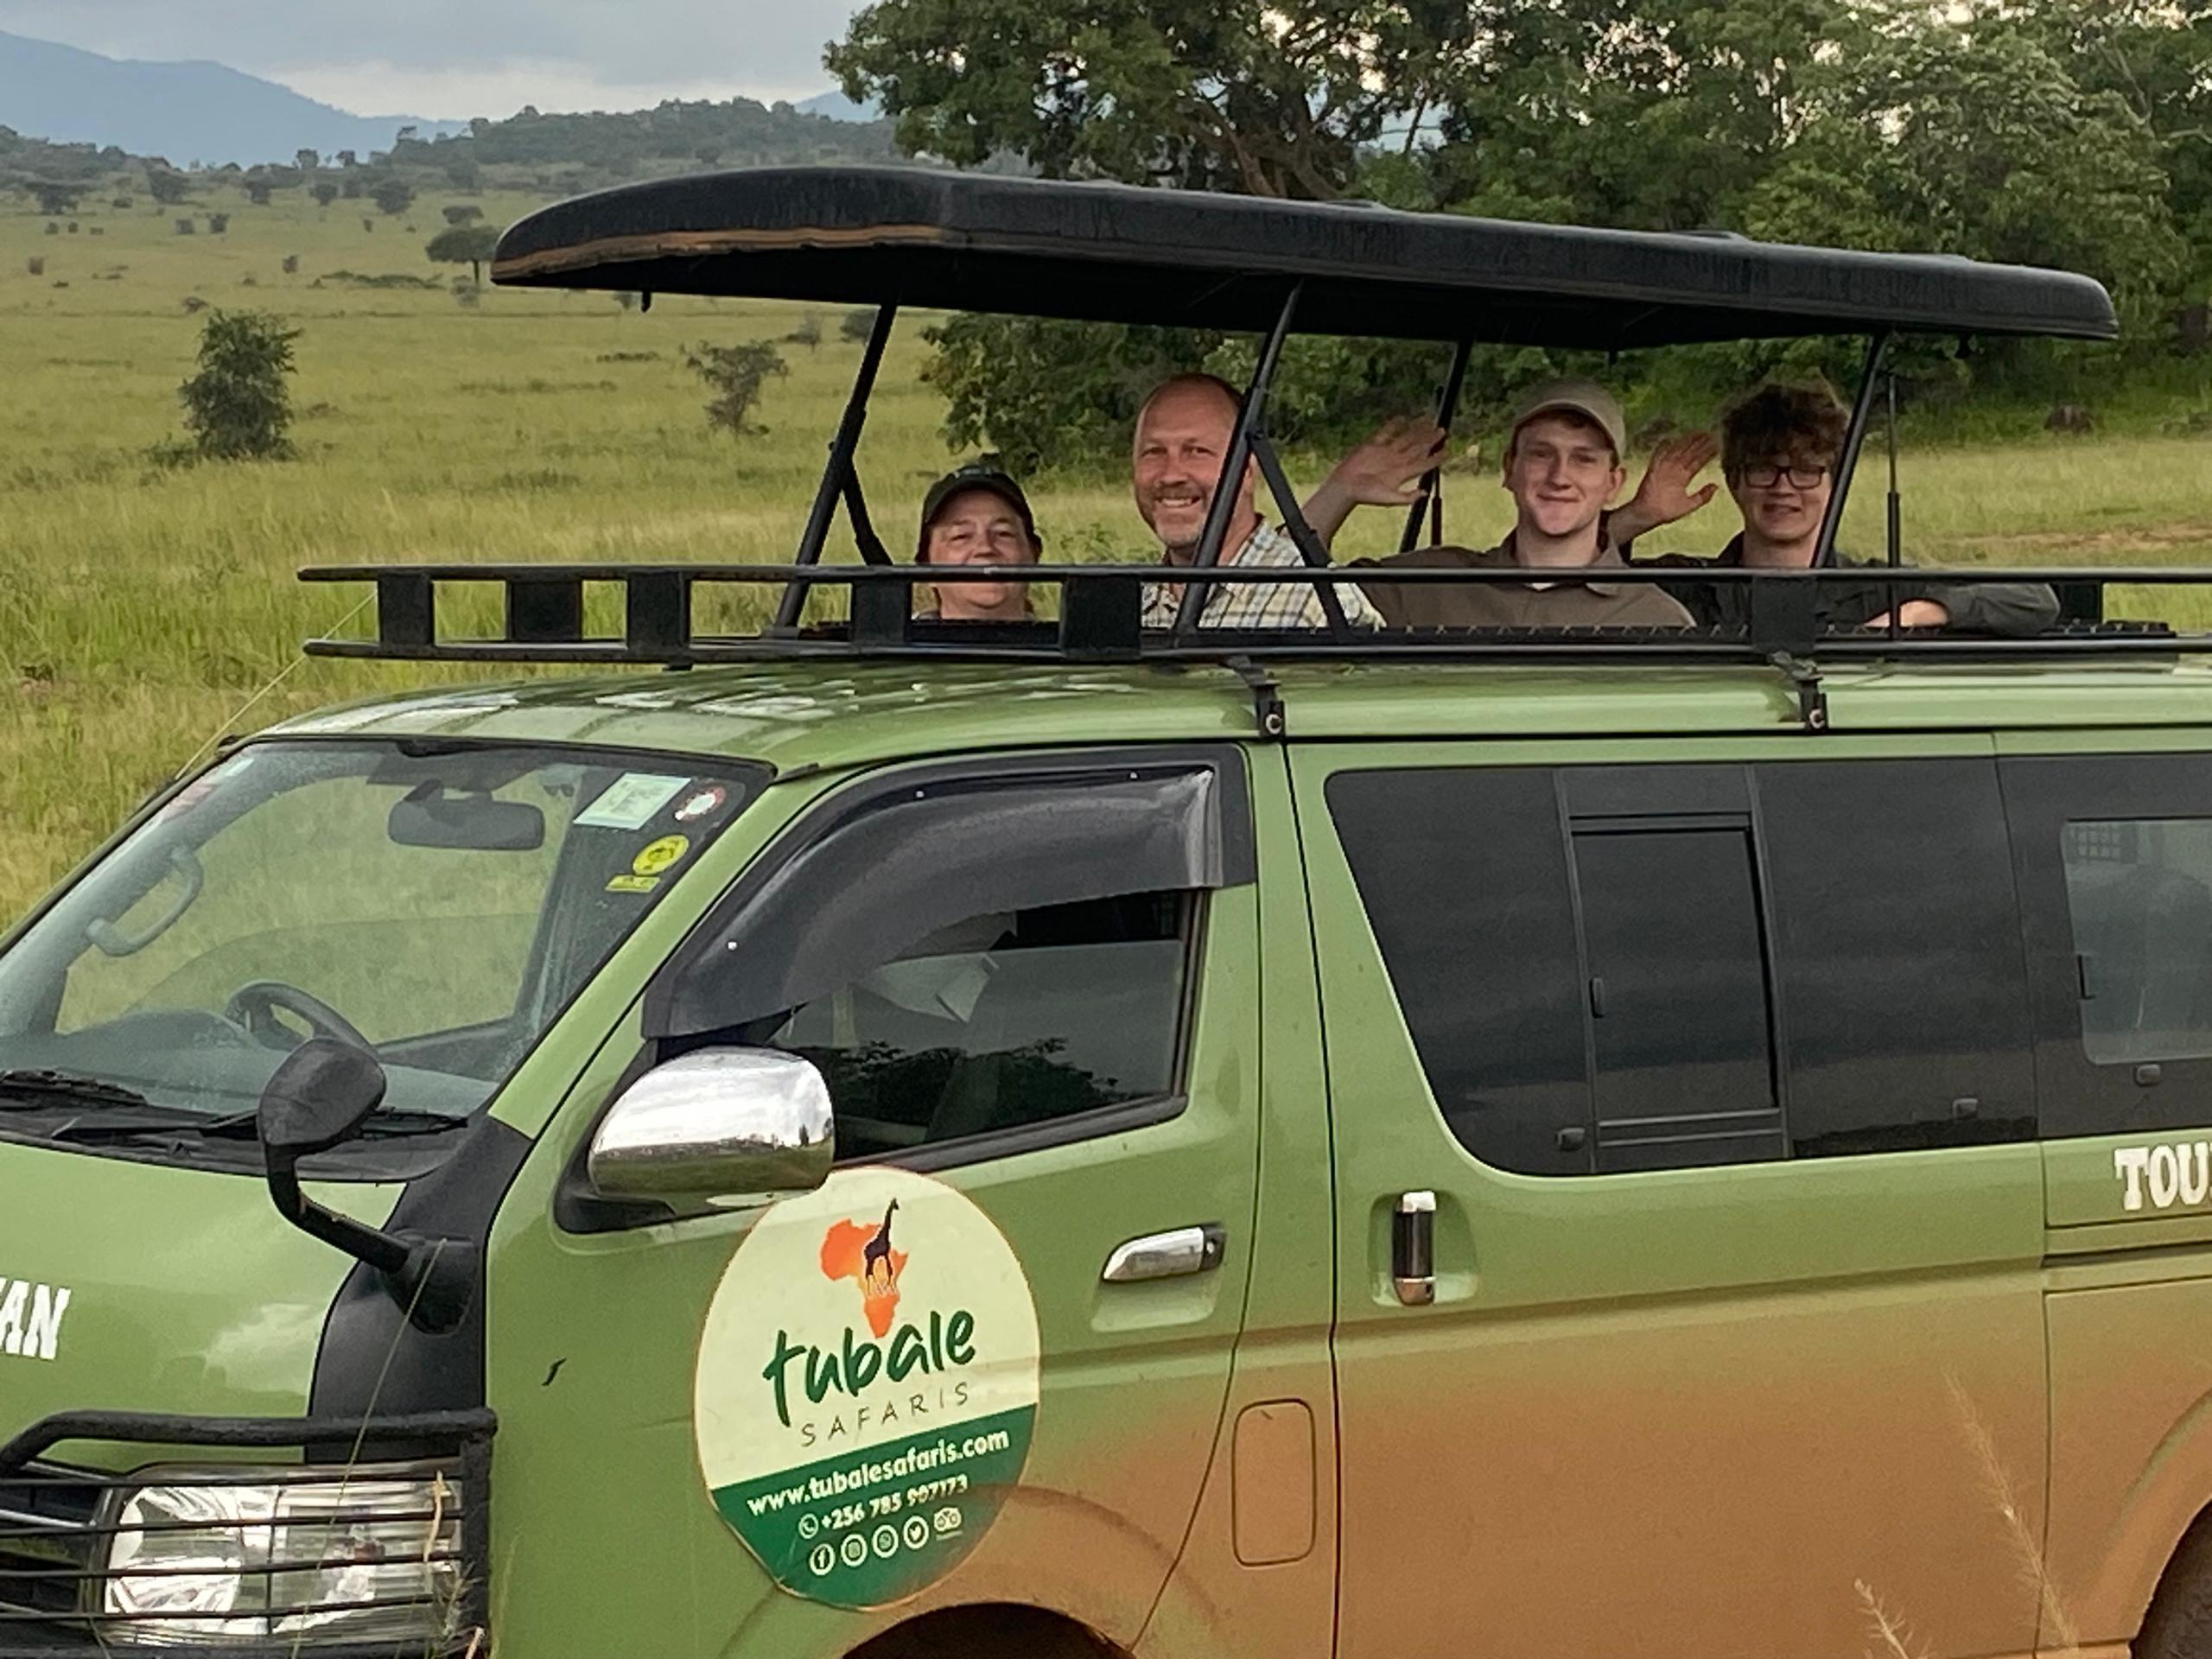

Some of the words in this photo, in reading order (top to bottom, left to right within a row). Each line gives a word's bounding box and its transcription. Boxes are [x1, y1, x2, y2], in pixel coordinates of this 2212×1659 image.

[2114, 1141, 2212, 1211] TOU
[0, 1276, 72, 1360] AN
[762, 1310, 976, 1427] tubale
[800, 1382, 969, 1447] SAFARIS
[747, 1429, 1010, 1516] www.tubalesafaris.com
[821, 1504, 866, 1530] +256
[869, 1492, 902, 1518] 785
